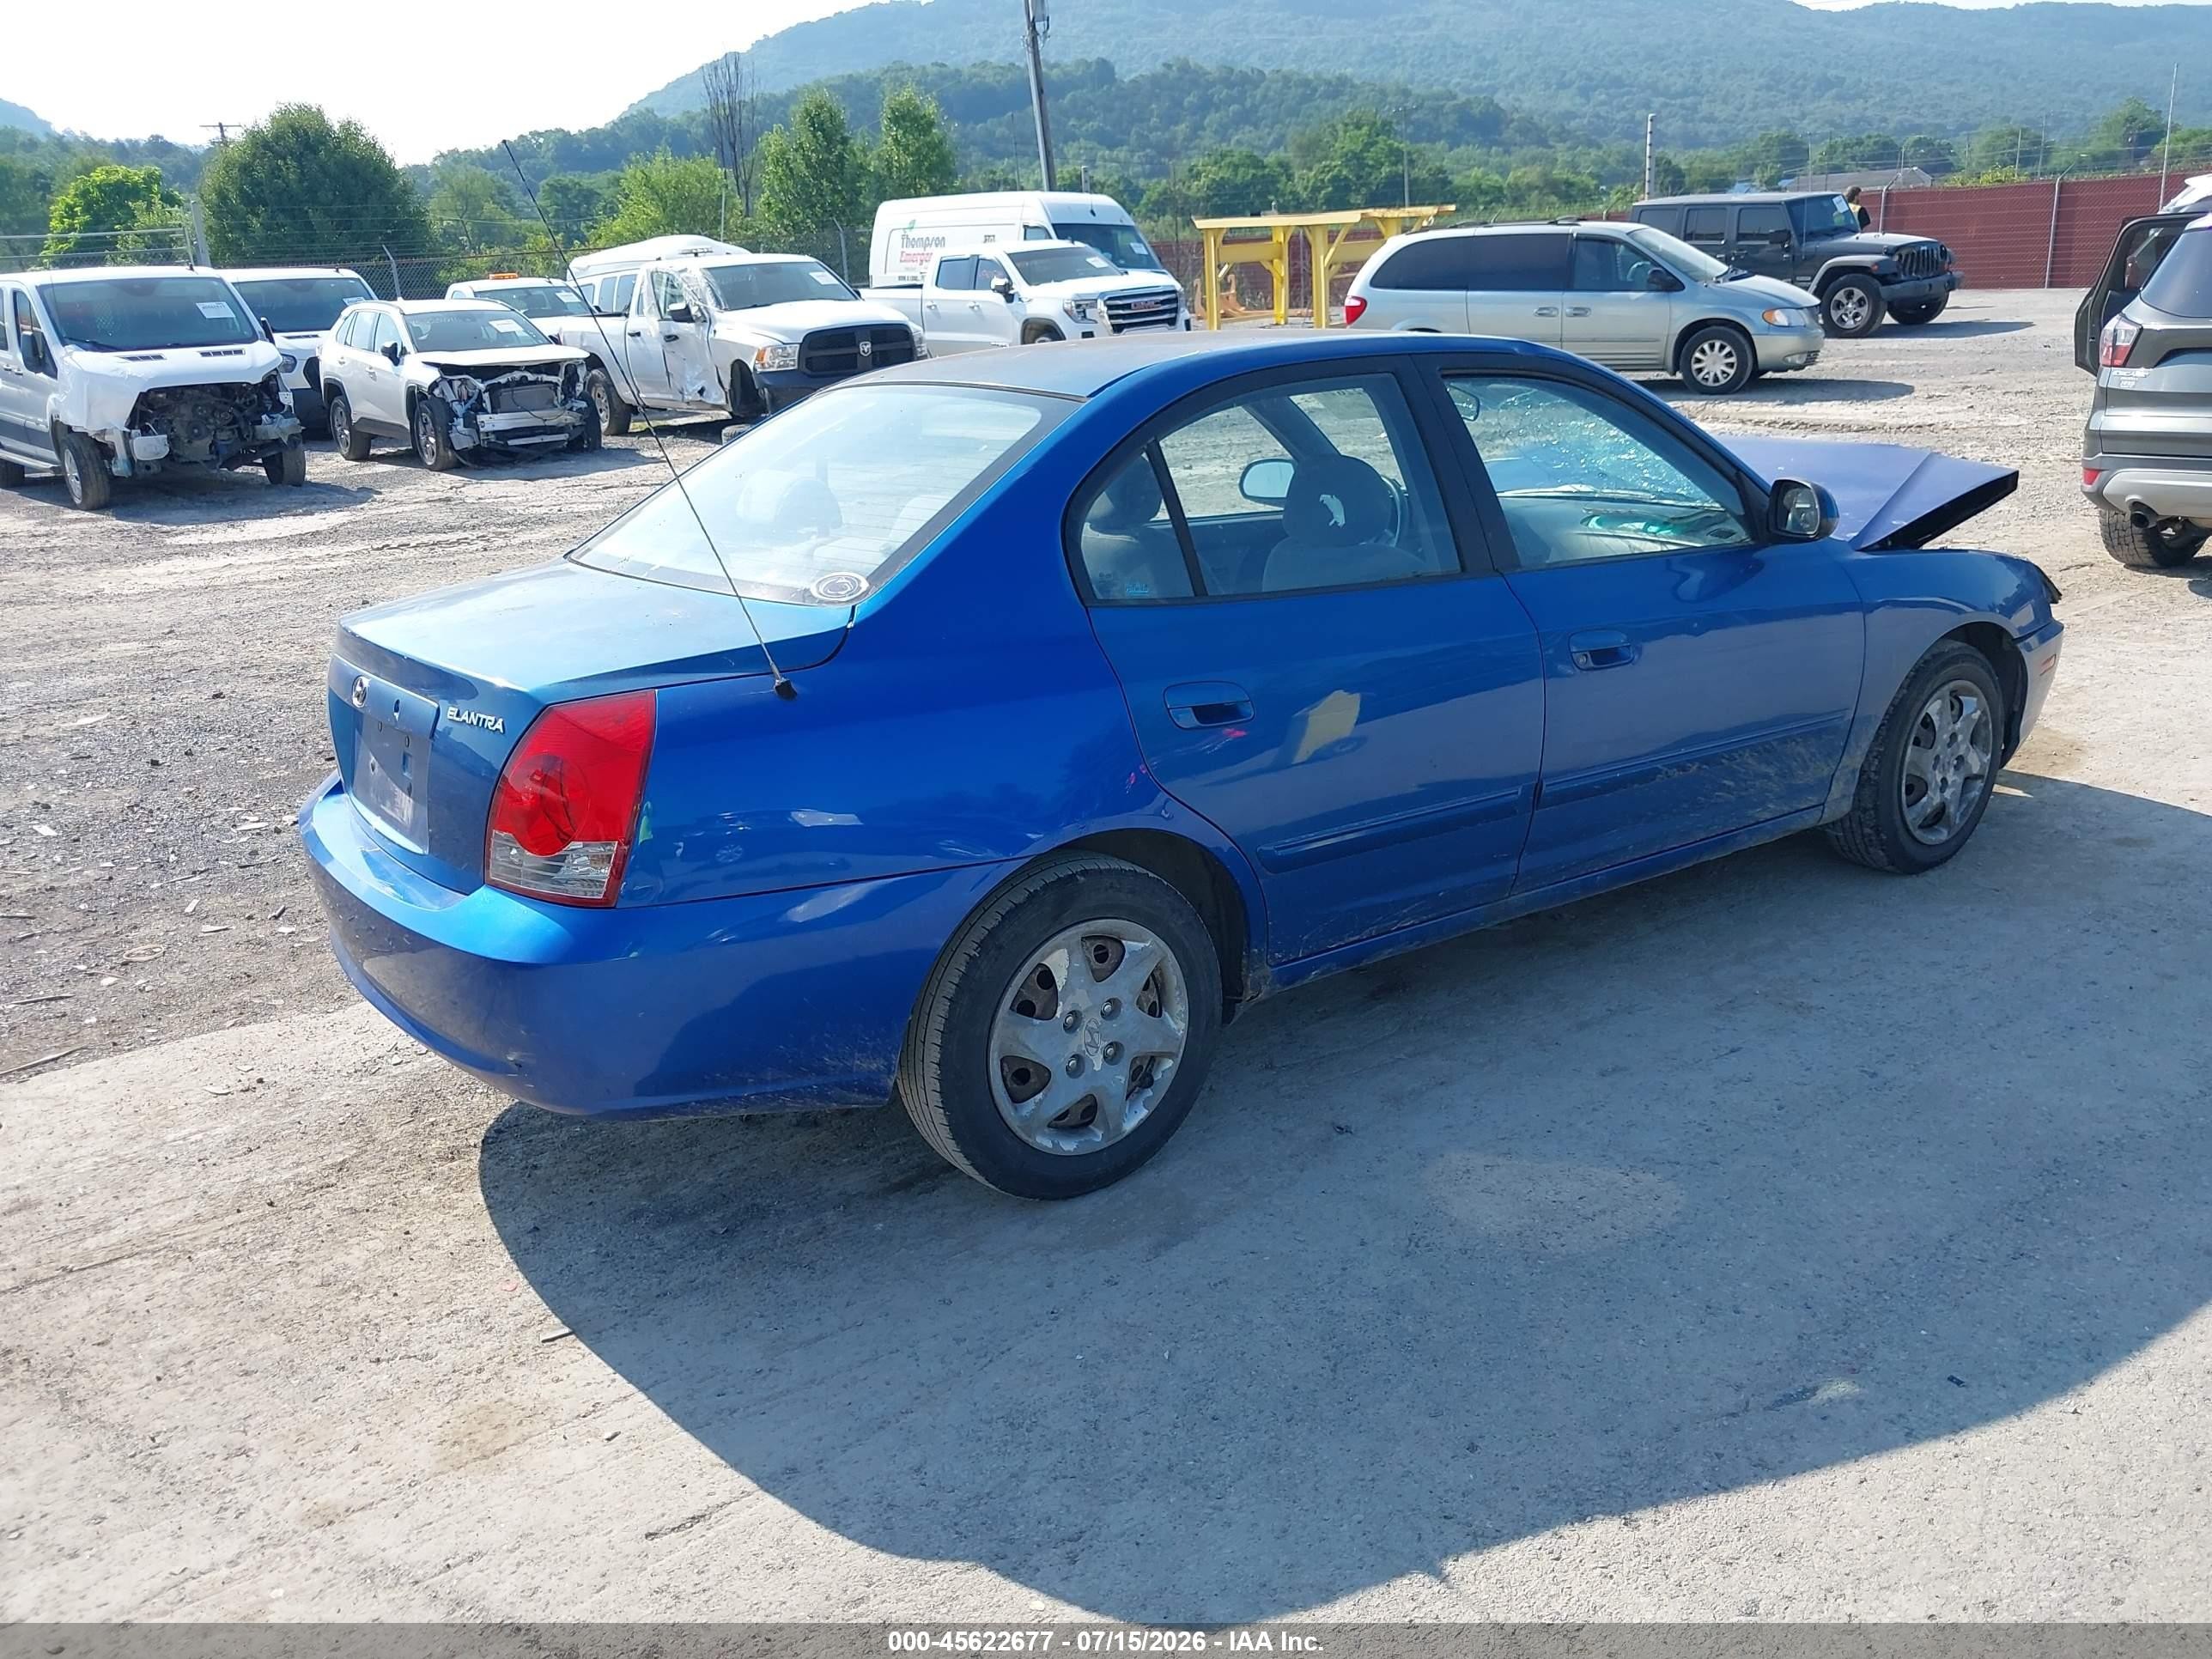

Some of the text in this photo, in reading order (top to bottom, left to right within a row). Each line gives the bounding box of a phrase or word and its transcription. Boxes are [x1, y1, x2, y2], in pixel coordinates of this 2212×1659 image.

[901, 234, 946, 252] Thompson
[1131, 300, 1162, 310] GMC
[446, 706, 505, 734] ELANTRA
